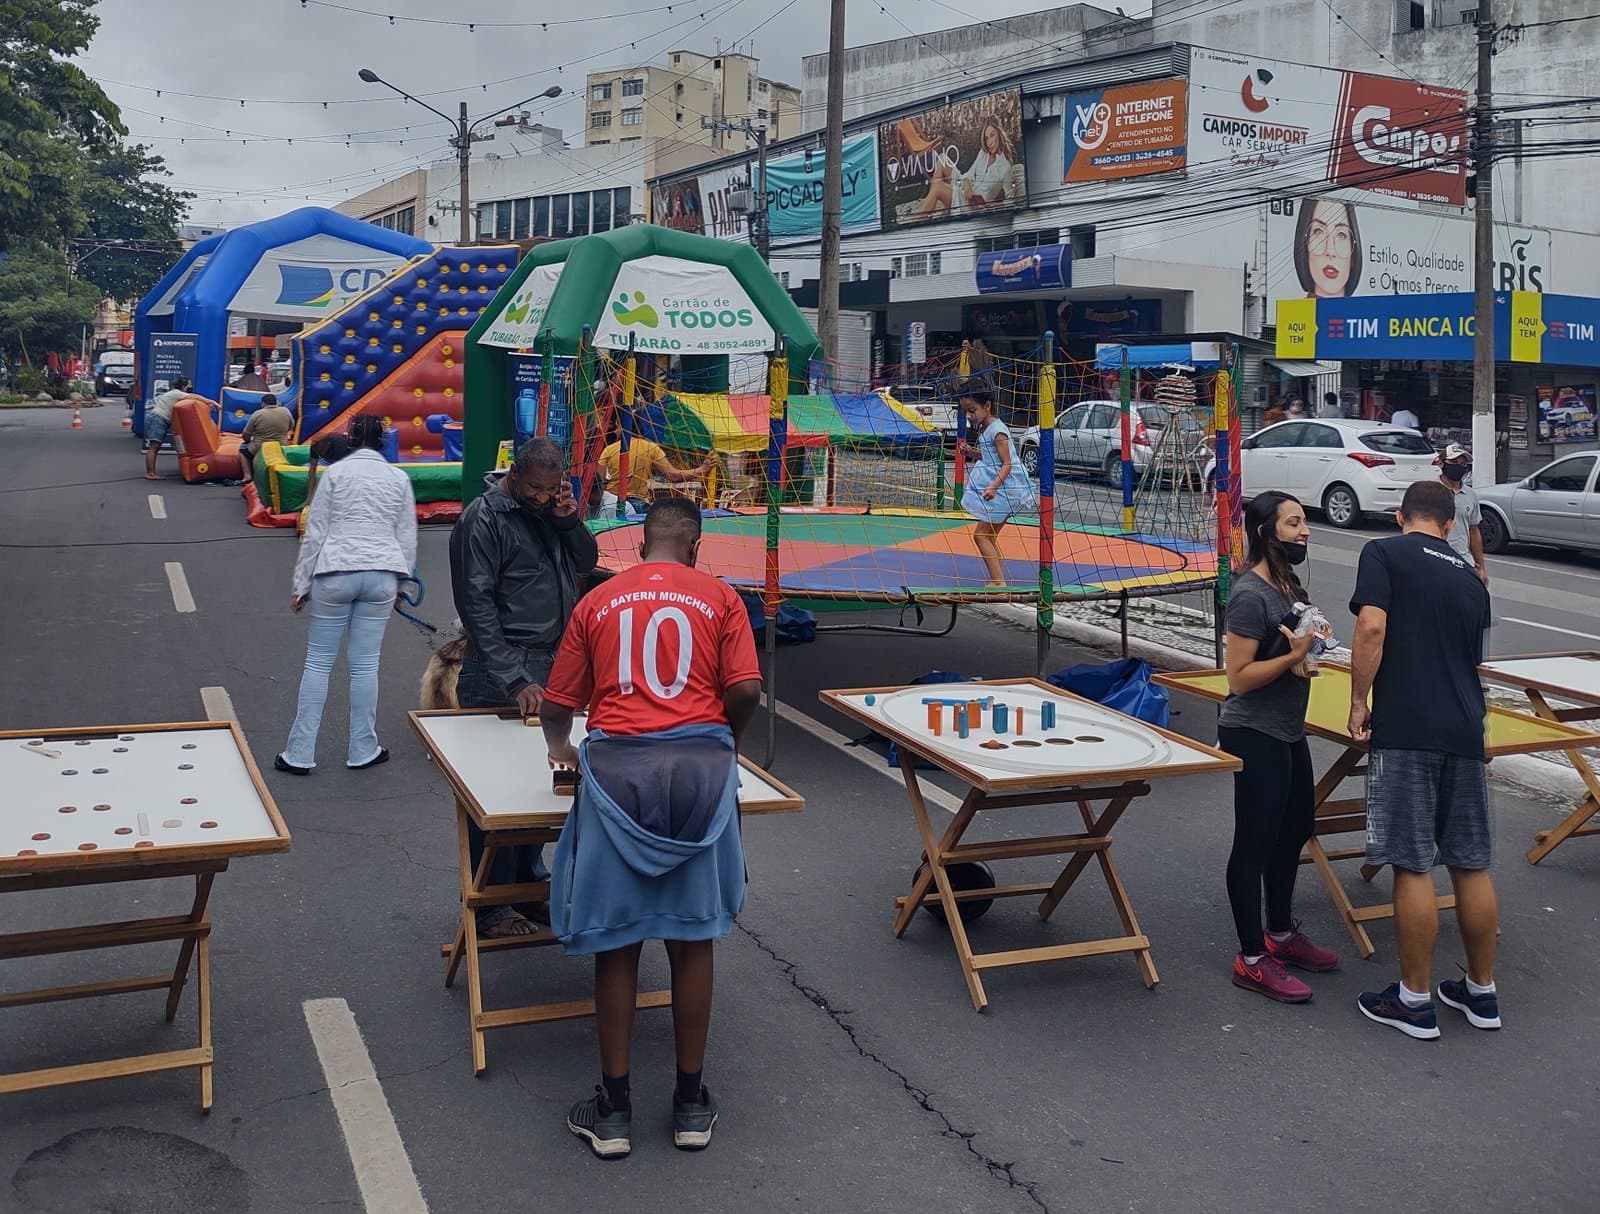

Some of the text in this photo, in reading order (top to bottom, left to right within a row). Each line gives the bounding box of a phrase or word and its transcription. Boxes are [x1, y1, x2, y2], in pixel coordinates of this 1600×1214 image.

[1116, 96, 1174, 115] INTERNET
[1115, 110, 1174, 126] E TELEFONE
[1118, 125, 1174, 139] ATENDIMENTO NO
[1134, 139, 1143, 147] DE
[1144, 134, 1174, 144] TUBARÃO
[1203, 118, 1309, 144] CAMPOS IMPORT
[1352, 105, 1460, 168] Campos
[1222, 136, 1290, 156] CAR SERVICE
[924, 145, 960, 173] UNO
[766, 171, 860, 211] PICCADLY
[1369, 245, 1465, 272] Estilo, Qualidade
[340, 268, 398, 294] CD
[1369, 276, 1376, 289] e
[1380, 267, 1422, 294] Ótimos
[662, 297, 730, 308] Cartão de
[664, 309, 753, 329] TODOS
[1288, 322, 1306, 333] AQUI
[1346, 318, 1378, 339] TIM
[1388, 317, 1453, 337] BANCA
[1518, 316, 1538, 327] AQUI
[608, 333, 681, 350] TUBARÃO
[697, 341, 711, 349] 48
[713, 339, 768, 349] 3052-4891
[1288, 335, 1304, 345] TEM
[1519, 328, 1536, 338] TEM
[1566, 322, 1594, 341] TIM
[596, 591, 715, 622] FC BAYERN MÜNCHEN
[618, 606, 693, 699] 10
